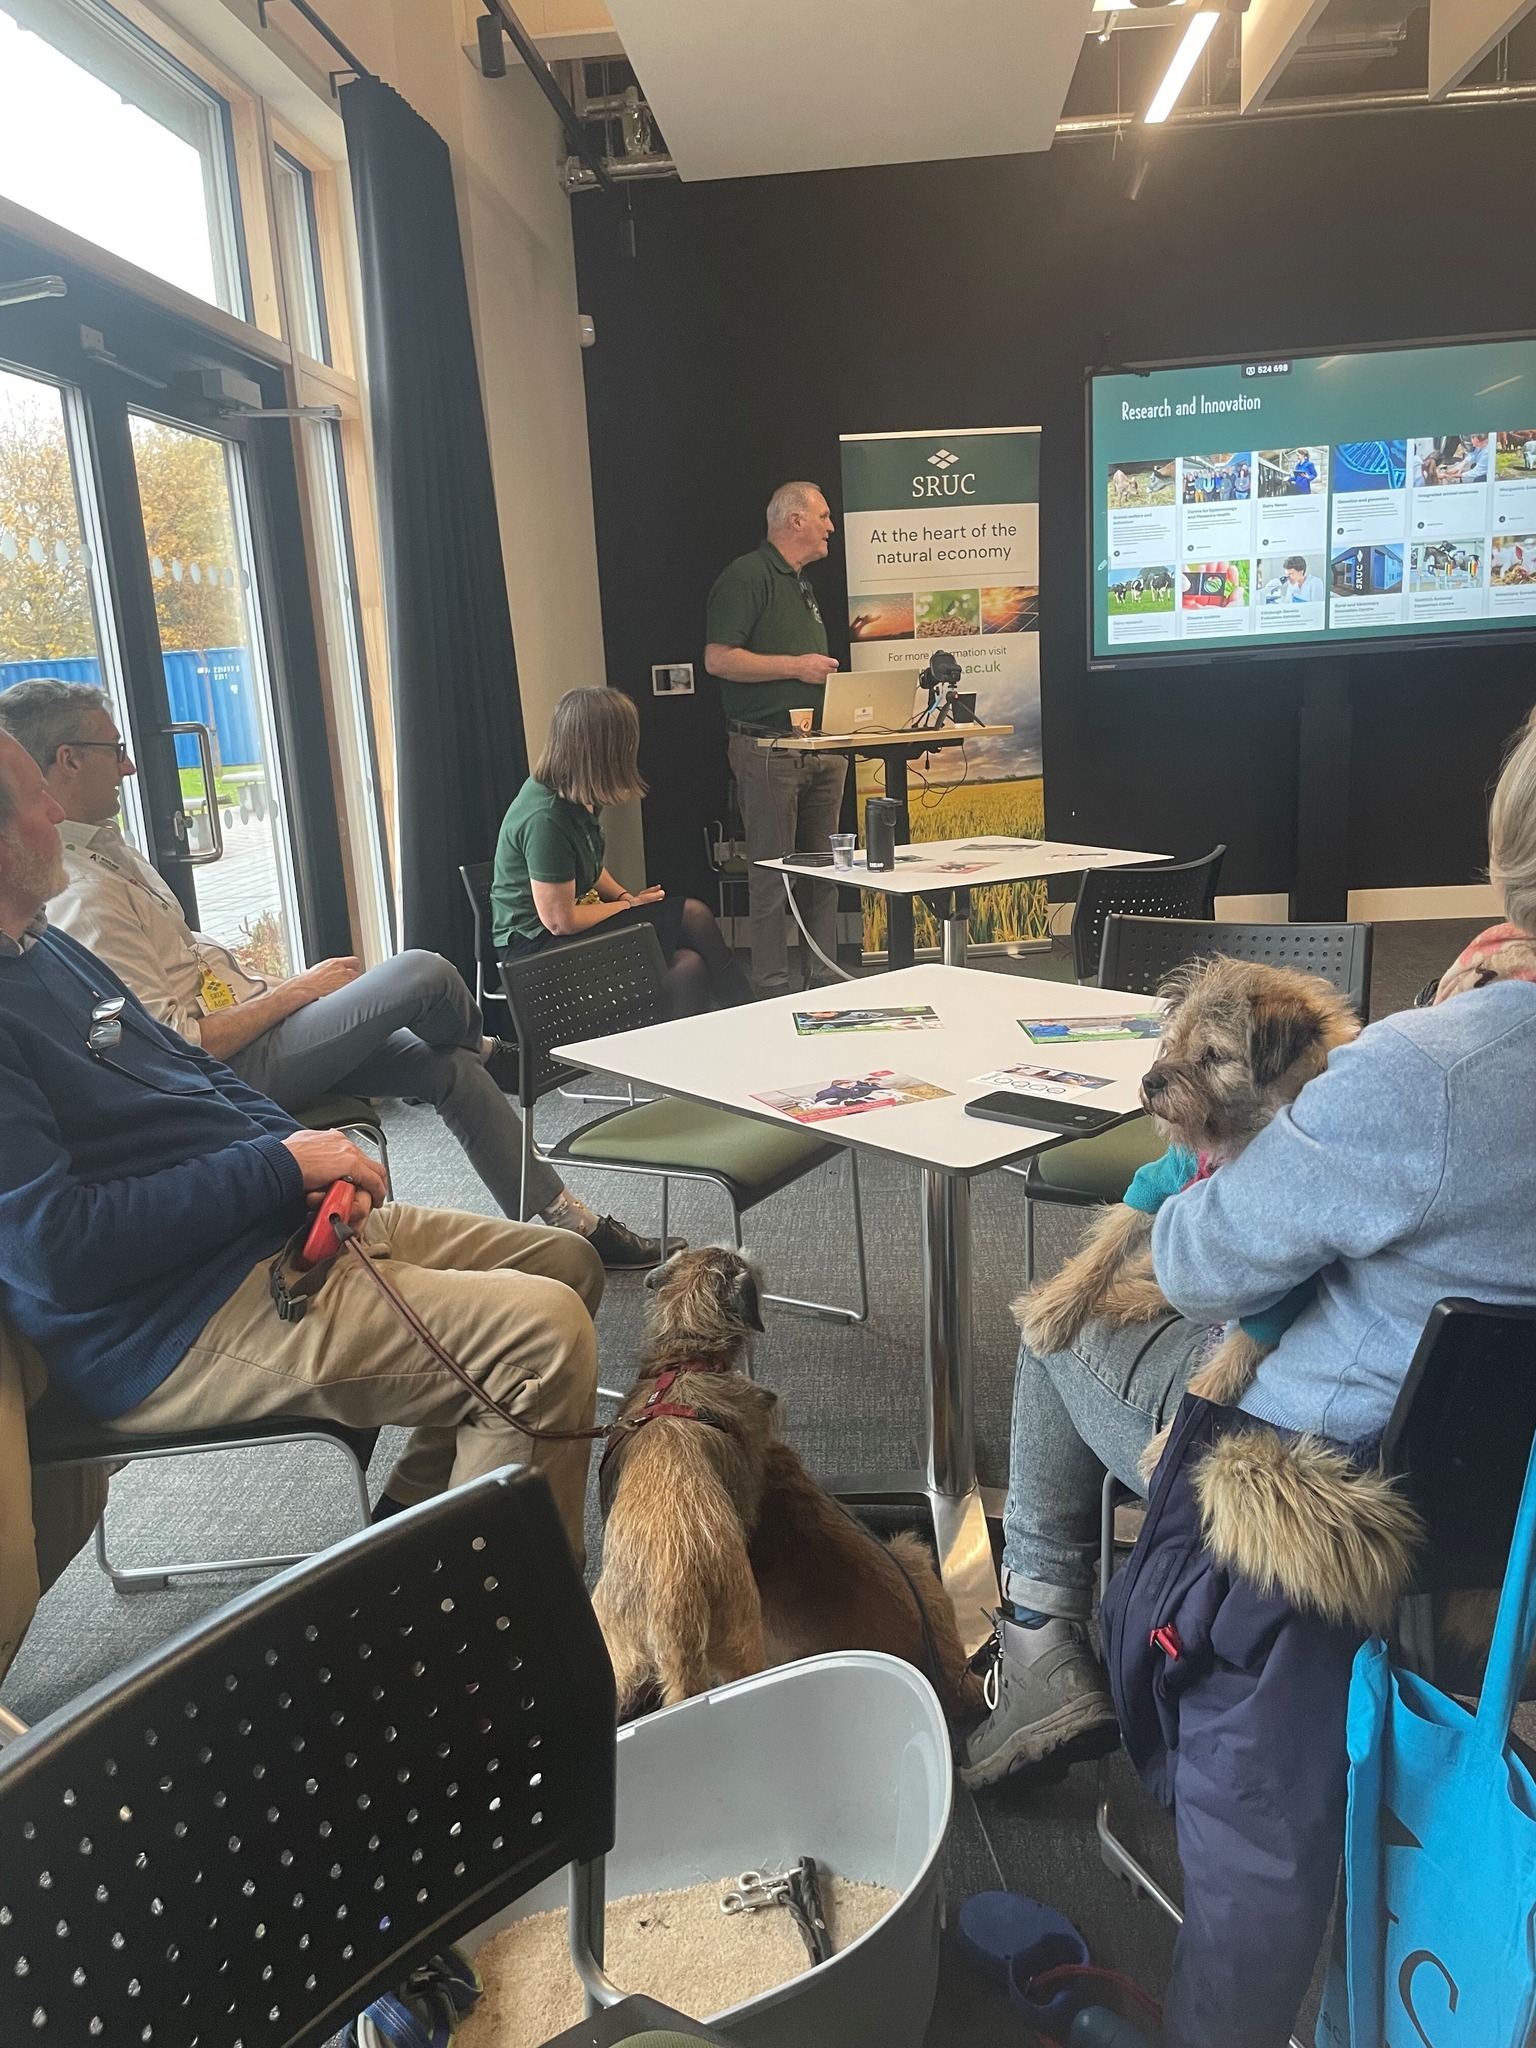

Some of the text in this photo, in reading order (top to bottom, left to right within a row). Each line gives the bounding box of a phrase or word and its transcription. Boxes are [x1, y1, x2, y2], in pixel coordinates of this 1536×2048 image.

[1257, 364, 1272, 374] 524
[1121, 393, 1261, 421] Research and Innovation
[912, 473, 976, 498] SRUC
[870, 522, 1017, 544] At the heart of the
[877, 546, 1012, 564] natural economy
[888, 652, 901, 662] For
[905, 651, 930, 661] more
[989, 646, 1007, 656] visit
